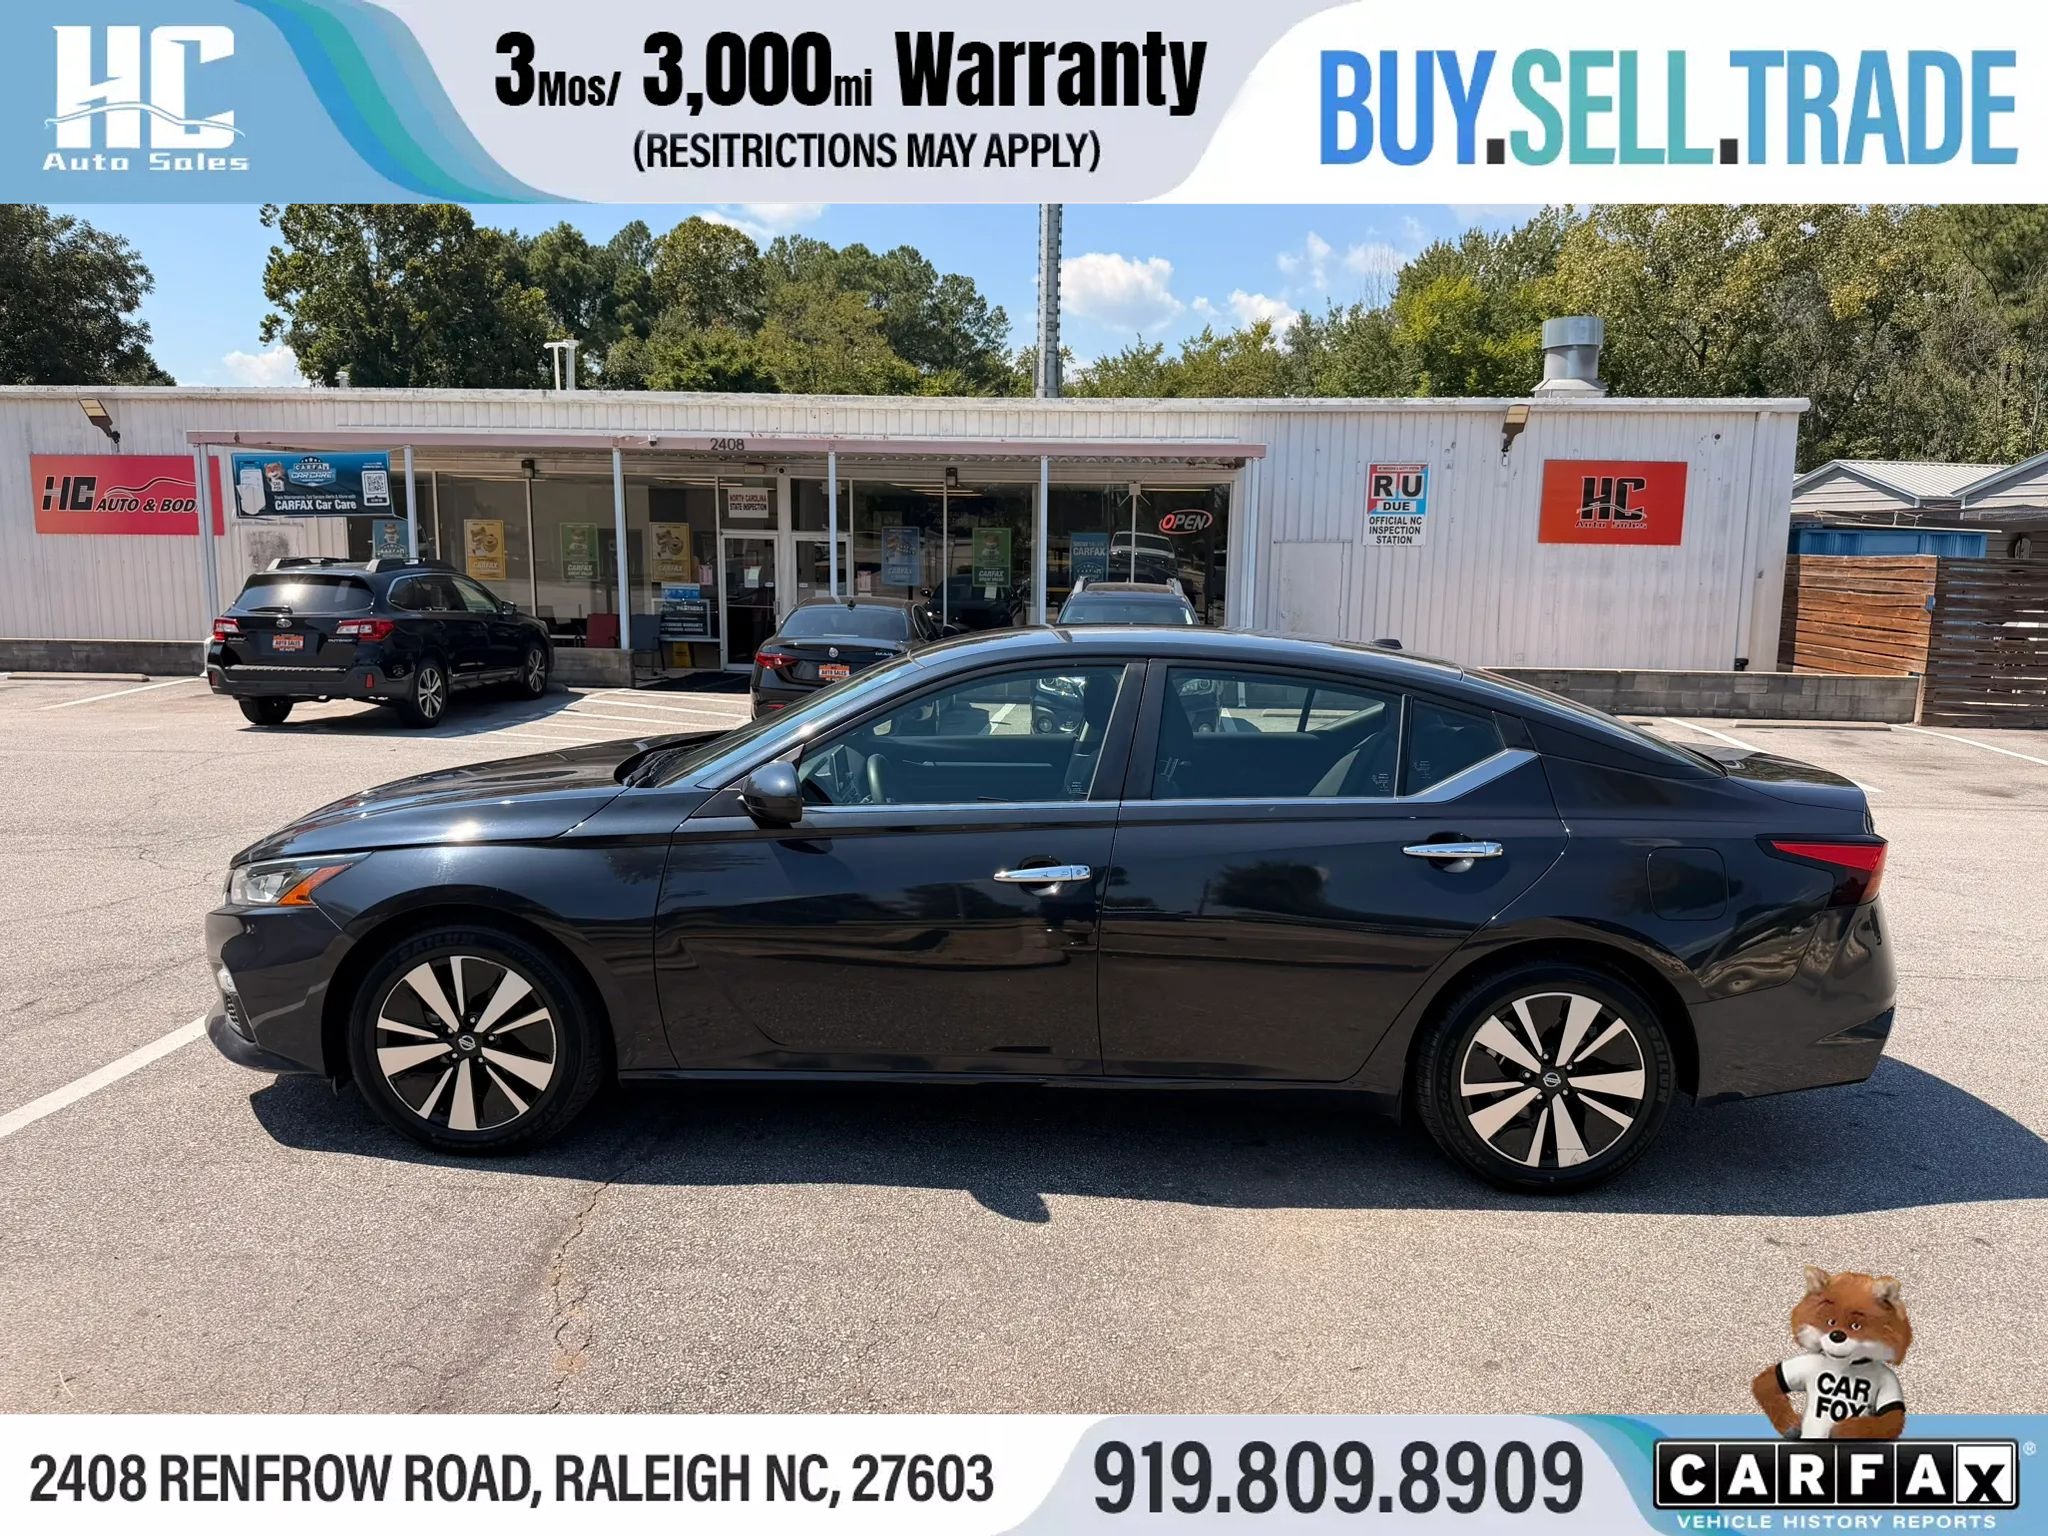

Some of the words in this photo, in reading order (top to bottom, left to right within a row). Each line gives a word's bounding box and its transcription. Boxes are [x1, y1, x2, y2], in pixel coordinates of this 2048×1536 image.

[710, 438, 745, 451] 2408
[41, 474, 98, 511] HC
[96, 498, 140, 513] AUTO
[143, 499, 157, 513] &
[159, 499, 199, 514] BOD
[729, 494, 744, 502] NORTH
[745, 494, 767, 502] CAROLINA
[1579, 475, 1647, 521] HC
[274, 499, 314, 511] CARFAX
[315, 499, 332, 510] Car
[334, 499, 357, 510] Care
[729, 503, 743, 511] STATE
[743, 503, 767, 511] INSPECTION
[1383, 502, 1410, 511] DUE
[1162, 513, 1207, 530] OPEN
[1369, 516, 1408, 525] OFFICIAL
[1409, 516, 1423, 526] NC
[1369, 526, 1421, 535] INSPECTION
[1376, 535, 1413, 544] STATION
[1073, 547, 1106, 556] CARFAX
[567, 564, 593, 572] CARFAX
